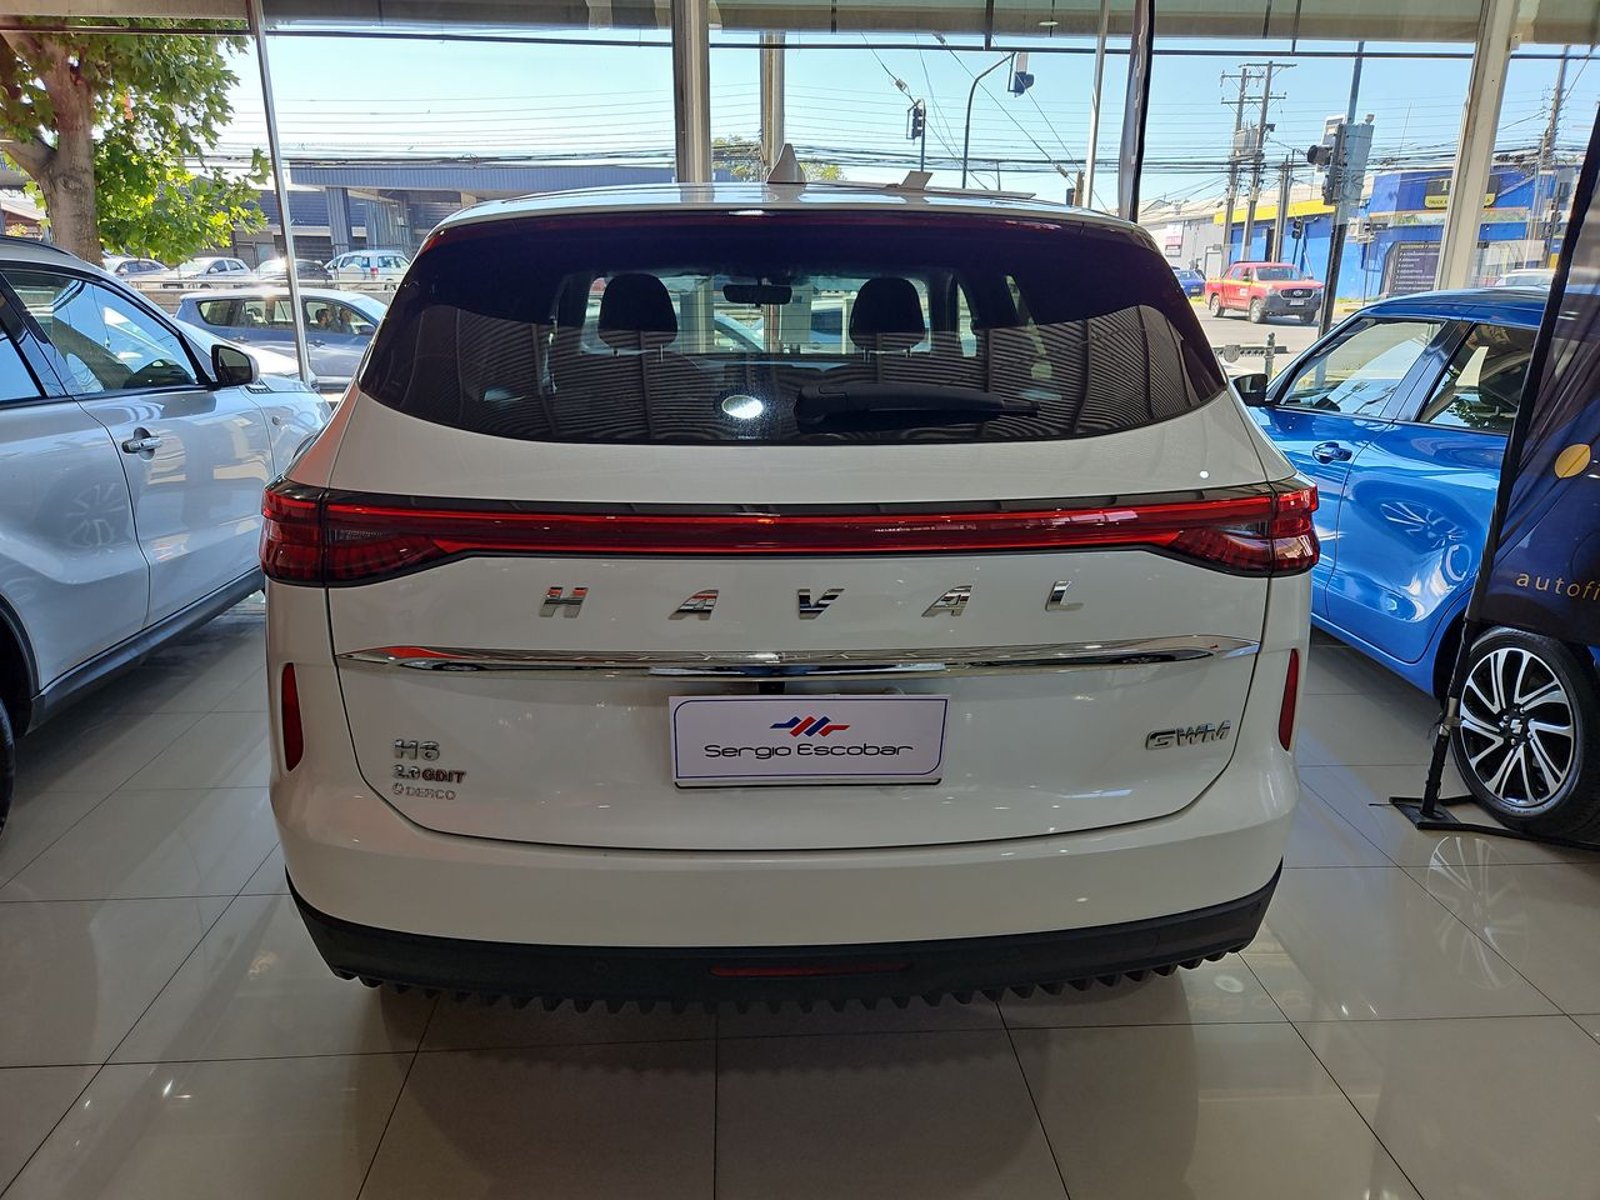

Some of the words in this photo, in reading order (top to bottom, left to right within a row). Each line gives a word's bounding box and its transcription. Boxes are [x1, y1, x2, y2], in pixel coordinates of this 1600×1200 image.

[537, 580, 1084, 620] HAVAL
[1145, 720, 1231, 751] GWM
[394, 739, 440, 761] H6
[704, 744, 792, 760] Sergio
[796, 743, 914, 756] Escobar
[405, 785, 457, 800] DERCO
